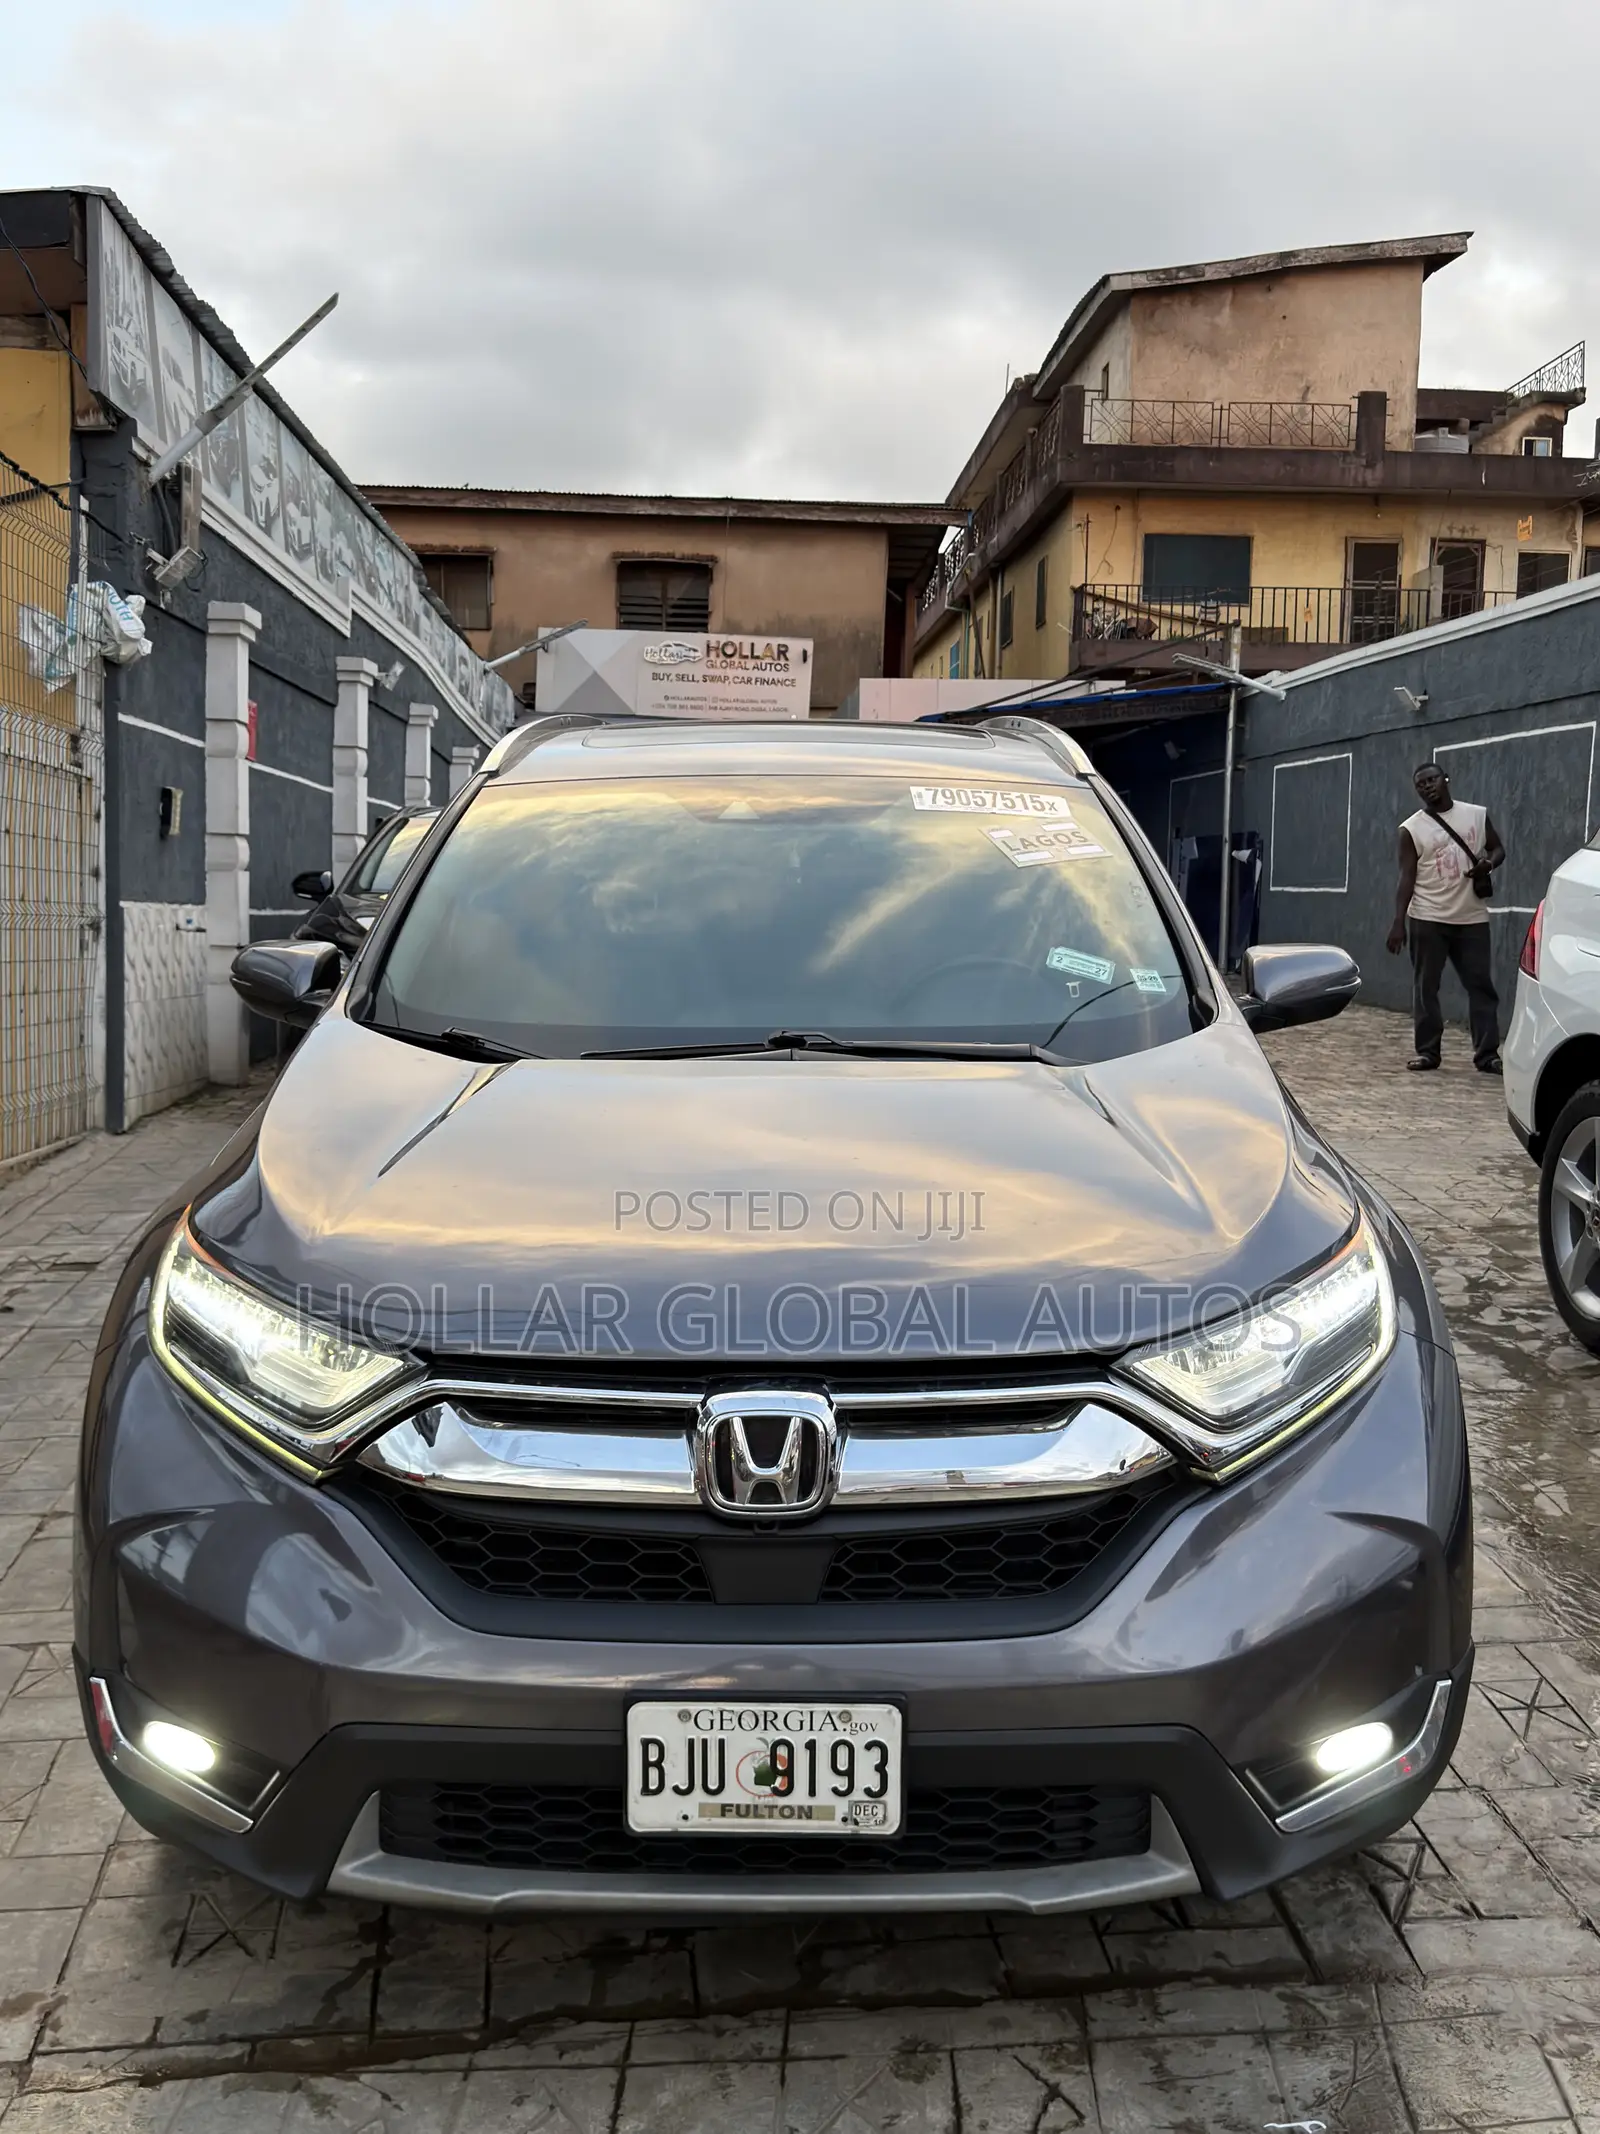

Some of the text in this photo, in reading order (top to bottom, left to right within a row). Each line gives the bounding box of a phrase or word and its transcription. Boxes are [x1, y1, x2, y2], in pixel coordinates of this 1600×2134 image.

[706, 640, 790, 662] HOLLAR
[706, 659, 790, 673] GLOBAL AUTOS
[732, 676, 753, 686] CAR
[754, 677, 797, 688] FINANCE
[1001, 831, 1089, 852] LAGOS
[640, 1735, 889, 1799] BJU 9193
[720, 1803, 813, 1820] FULTON
[854, 1804, 879, 1817] DEC
